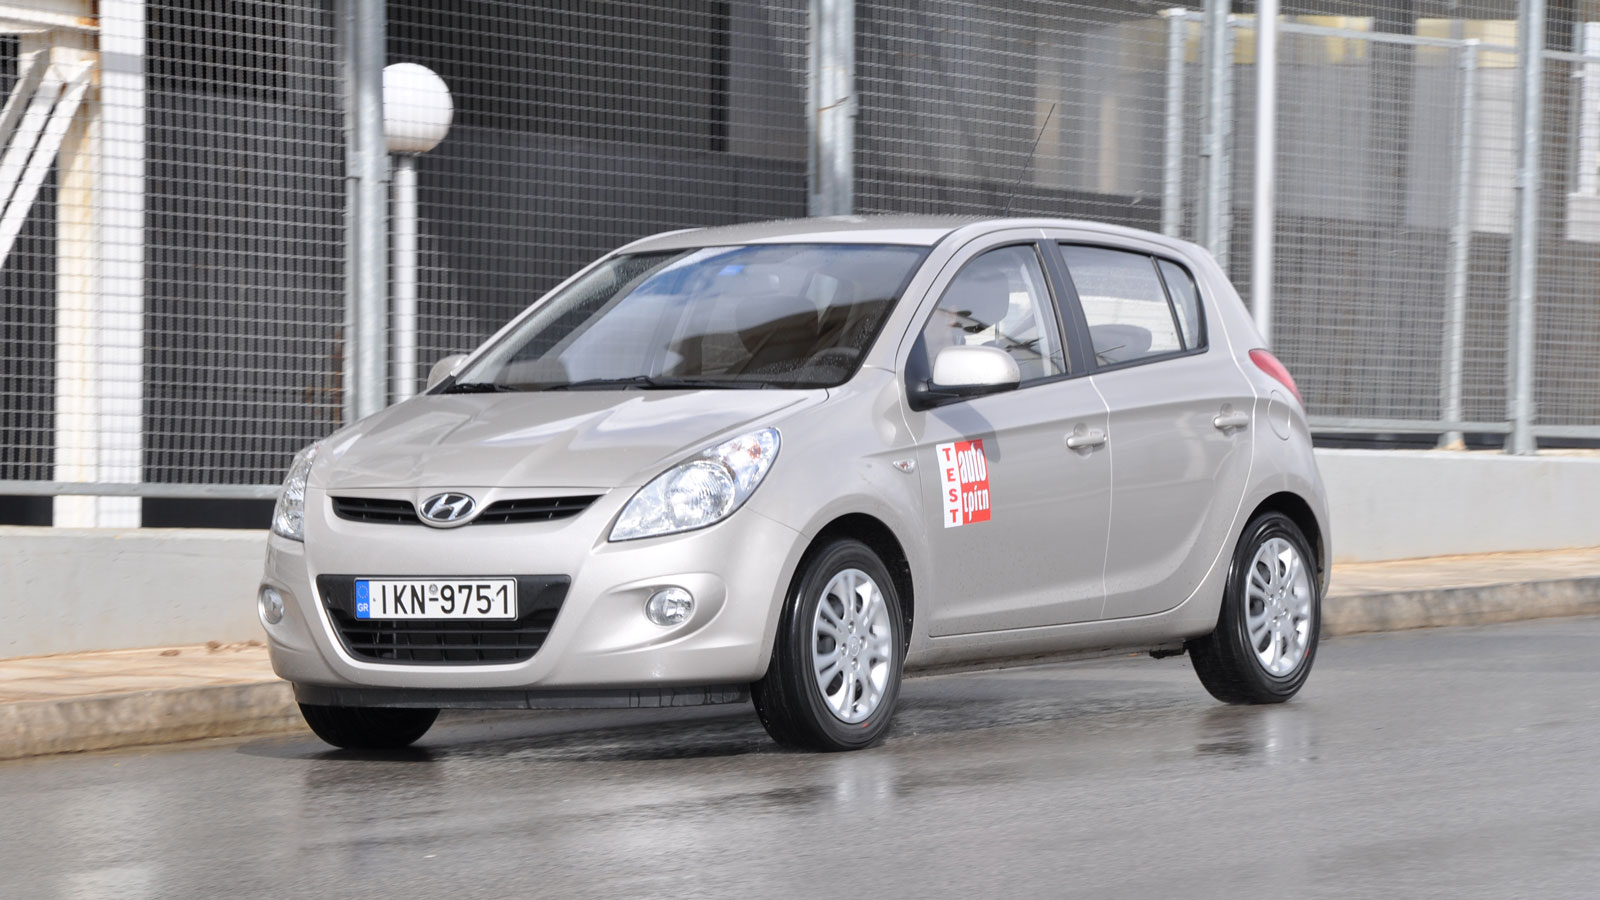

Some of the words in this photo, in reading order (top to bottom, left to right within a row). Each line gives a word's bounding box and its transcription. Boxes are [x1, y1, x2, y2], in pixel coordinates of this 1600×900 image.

[957, 441, 987, 485] auto
[942, 447, 958, 523] TEST
[962, 484, 989, 523] τρίτη
[357, 602, 369, 613] GR
[381, 584, 508, 615] IKN-9751
